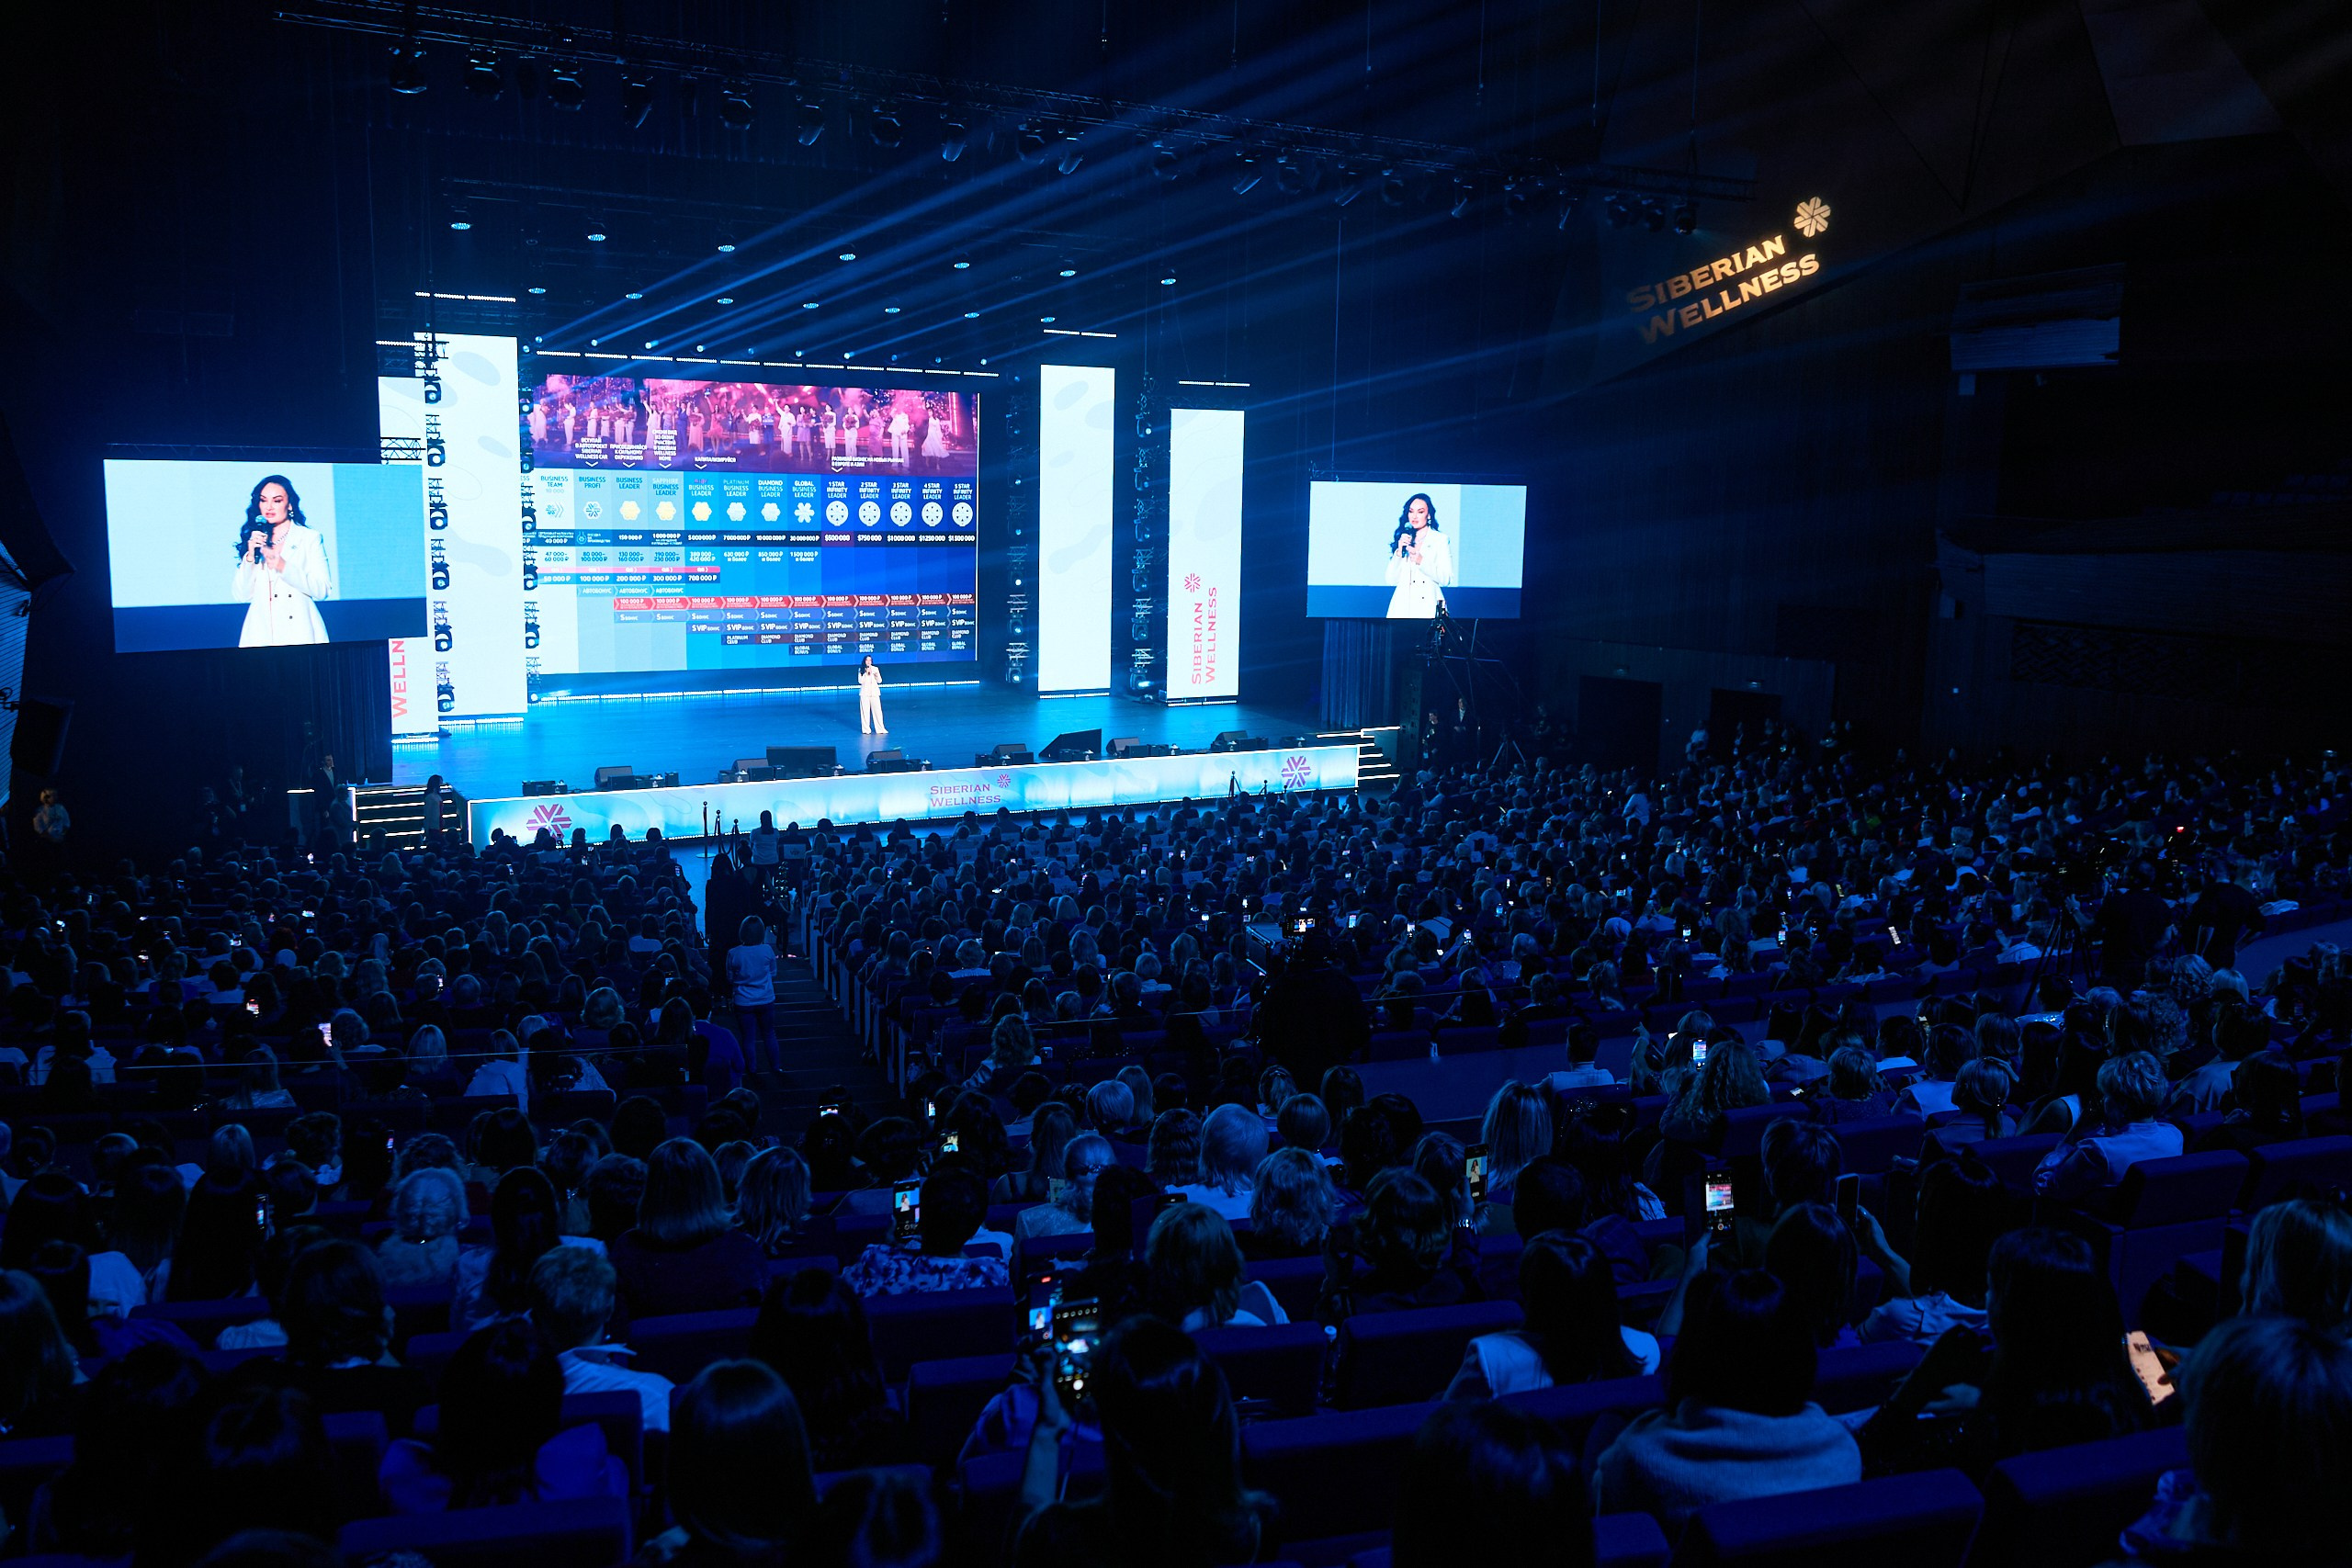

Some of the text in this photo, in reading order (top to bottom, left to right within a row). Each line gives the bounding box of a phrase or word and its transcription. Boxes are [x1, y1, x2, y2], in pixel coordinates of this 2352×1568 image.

[1627, 235, 1785, 312] SIBERIAN
[1634, 254, 1820, 344] WELLNESS
[1192, 603, 1203, 684] SIBERIAN
[1205, 587, 1217, 683] WELLNESS
[392, 640, 408, 718] WELLN
[930, 784, 990, 795] SIBERIAN
[931, 795, 1001, 807] WELLNESS
